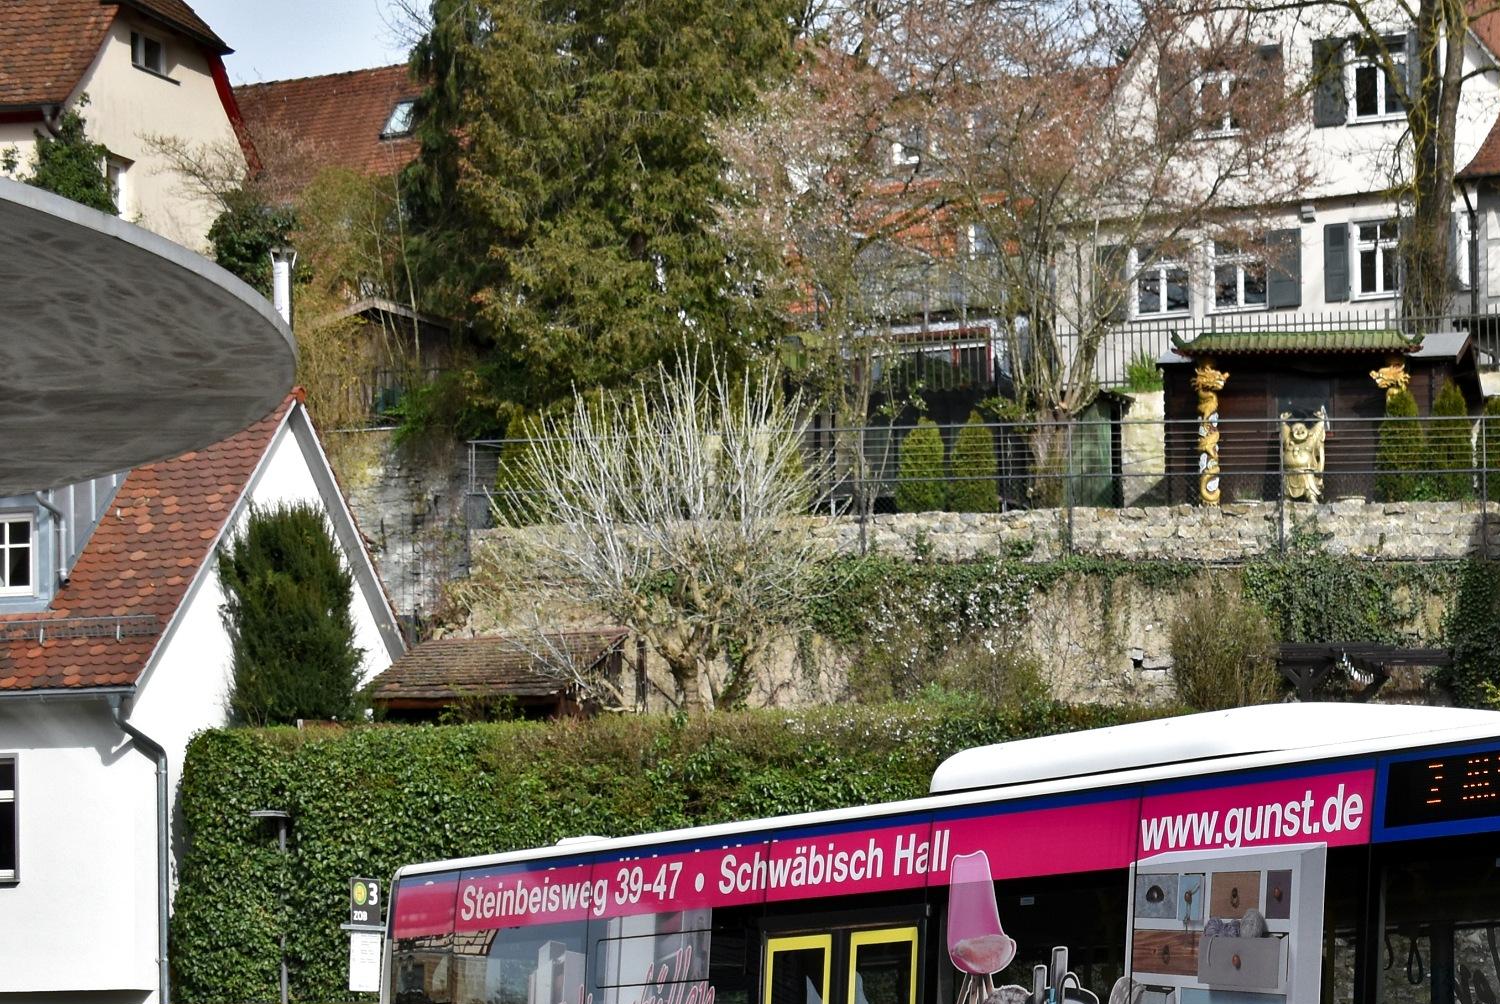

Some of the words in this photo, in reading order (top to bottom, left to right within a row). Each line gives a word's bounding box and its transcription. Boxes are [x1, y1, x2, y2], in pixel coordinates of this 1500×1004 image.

[1141, 783, 1364, 852] www.gunst.de
[368, 882, 378, 905] 3
[461, 876, 608, 921] Steinbeisweg
[614, 861, 683, 906] 39-47
[718, 838, 884, 895] Schwäbisch
[893, 829, 951, 876] Hall
[353, 910, 368, 921] ZOB
